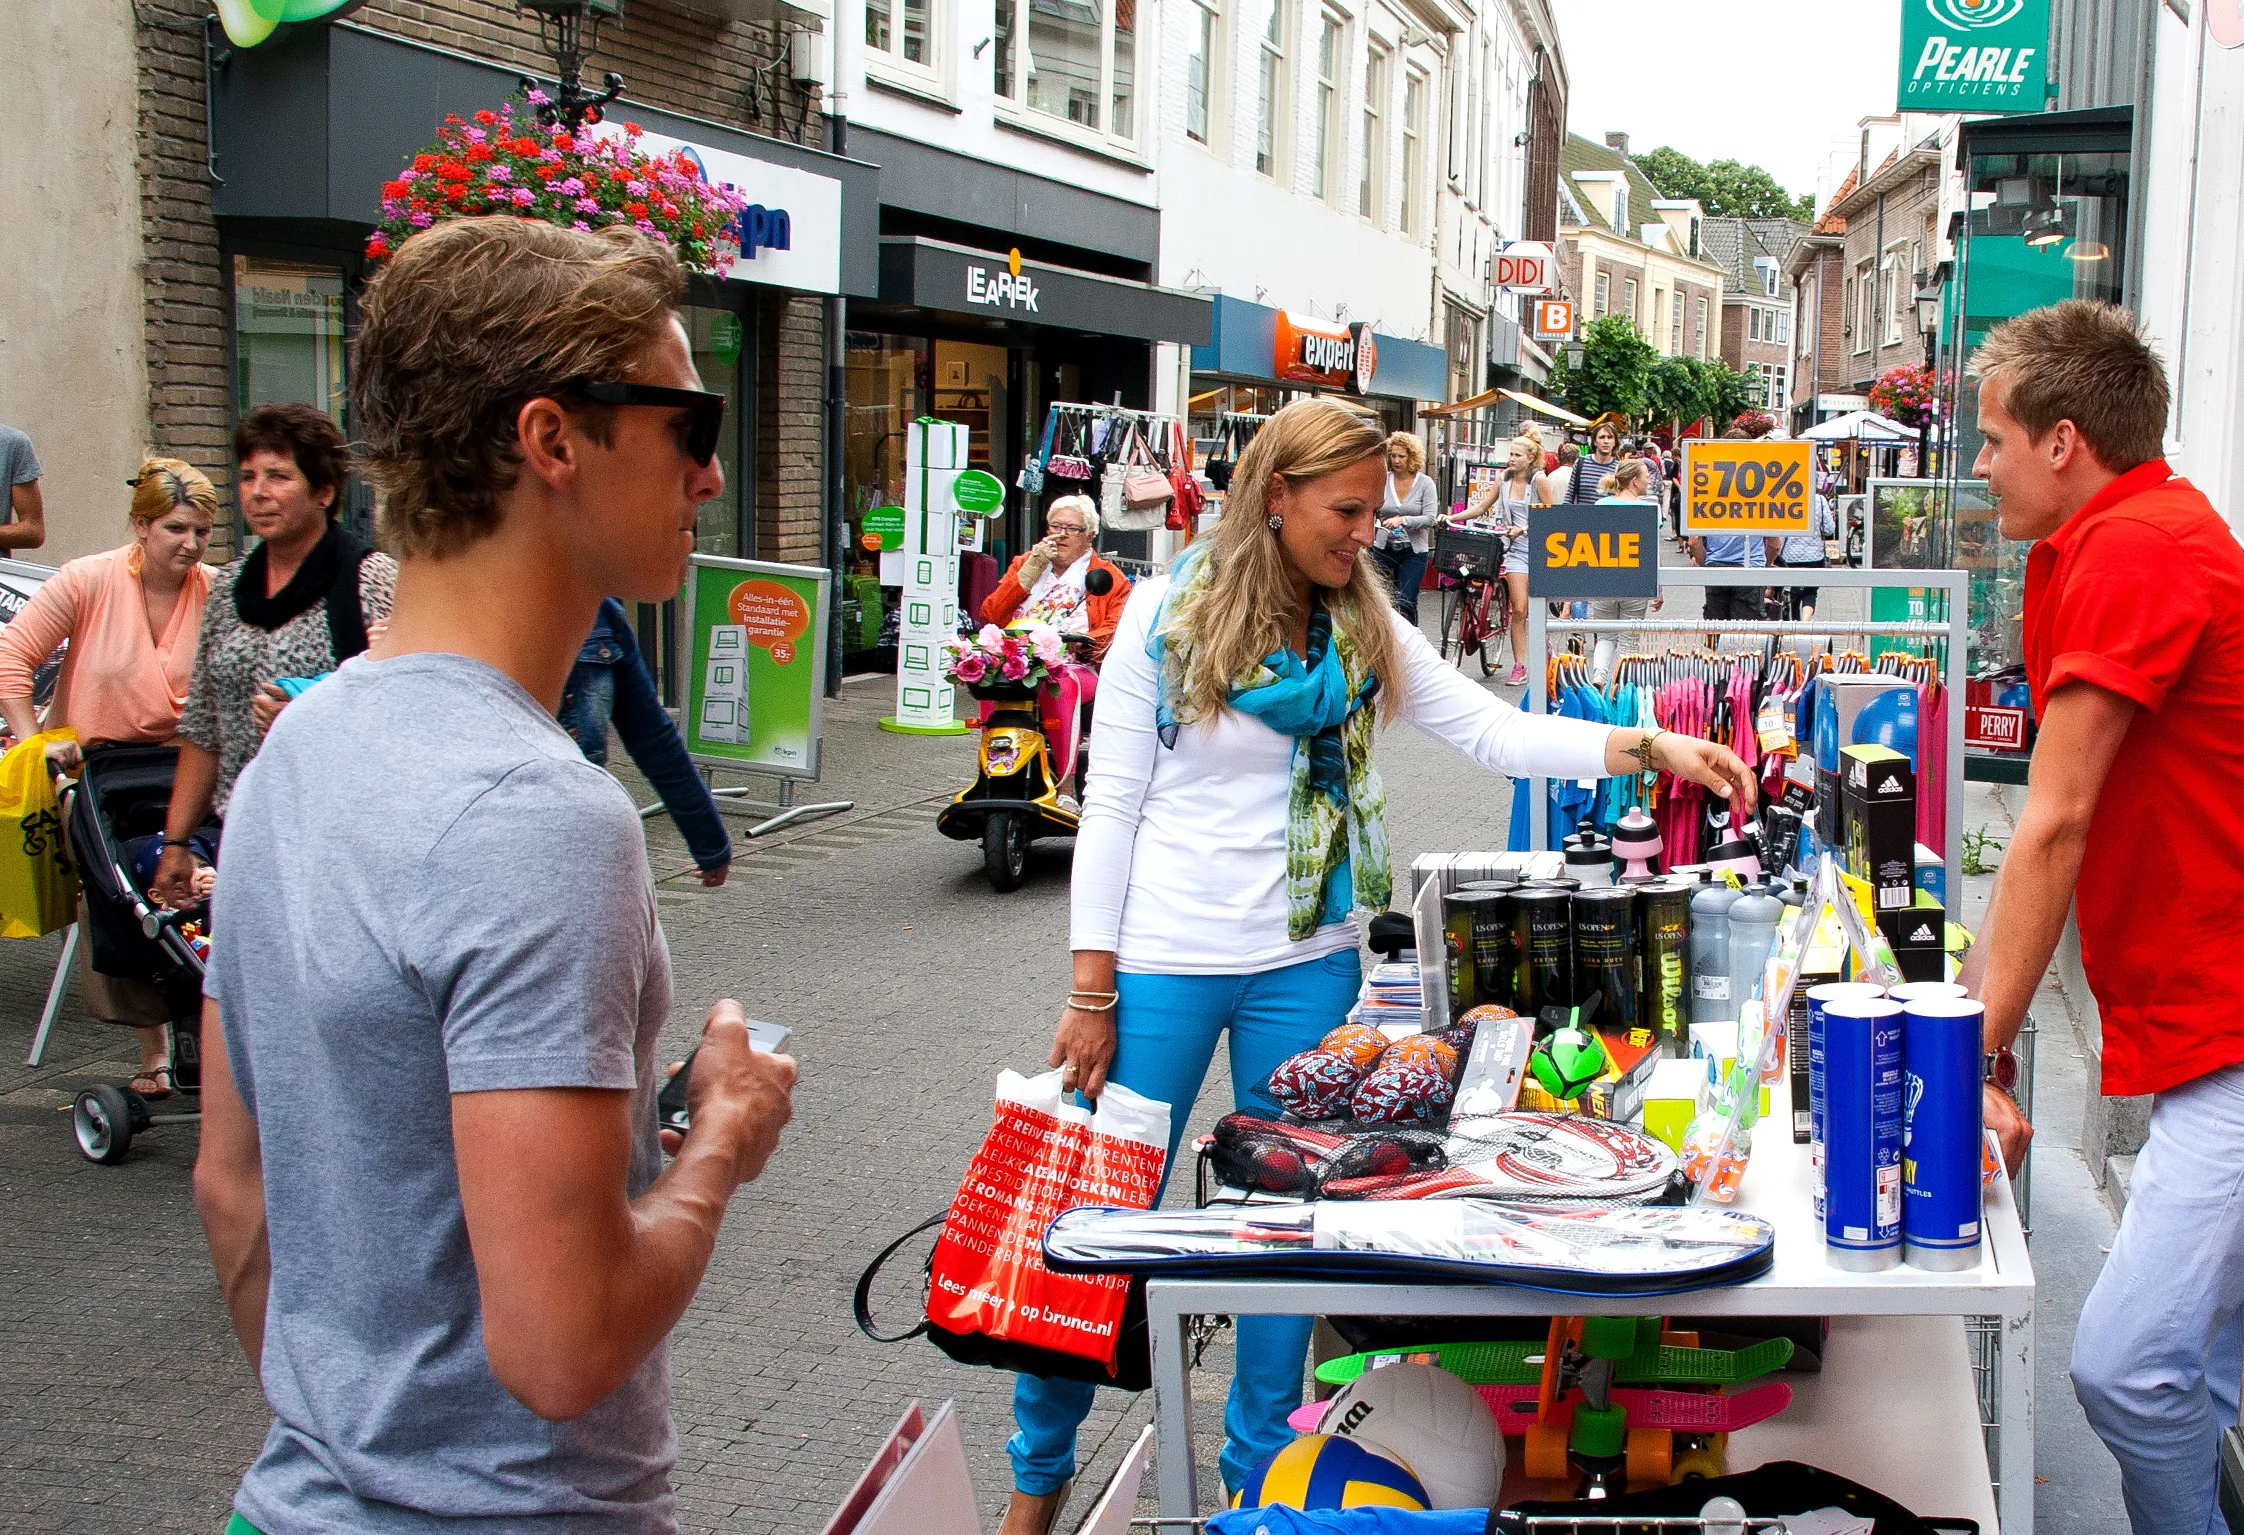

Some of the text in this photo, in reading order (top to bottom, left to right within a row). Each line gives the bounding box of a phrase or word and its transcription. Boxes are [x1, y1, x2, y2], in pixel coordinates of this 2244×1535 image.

[1913, 36, 2035, 83] PEARLE
[1907, 80, 2021, 96] OPTICIENS
[1498, 257, 1544, 286] DIDI
[1546, 304, 1567, 330] B
[1305, 334, 1354, 374] expert
[1693, 459, 1804, 499] TOT 70%
[1692, 501, 1804, 520] KORTING
[1545, 532, 1640, 569] SALE
[738, 602, 798, 617] Standaard met
[743, 613, 791, 627] Installatie-
[748, 626, 785, 637] garantie
[1980, 714, 2017, 737] PERRY
[1878, 785, 1904, 794] adidas
[1532, 922, 1563, 932] US OPEN
[1586, 924, 1609, 932] OPEN
[1654, 931, 1682, 940] US OPEN
[1910, 932, 1936, 941] adidas
[1661, 949, 1682, 1030] Wilson
[1629, 1027, 1651, 1049] NERF
[938, 1273, 1113, 1337] Lees meer op bruna.nl
